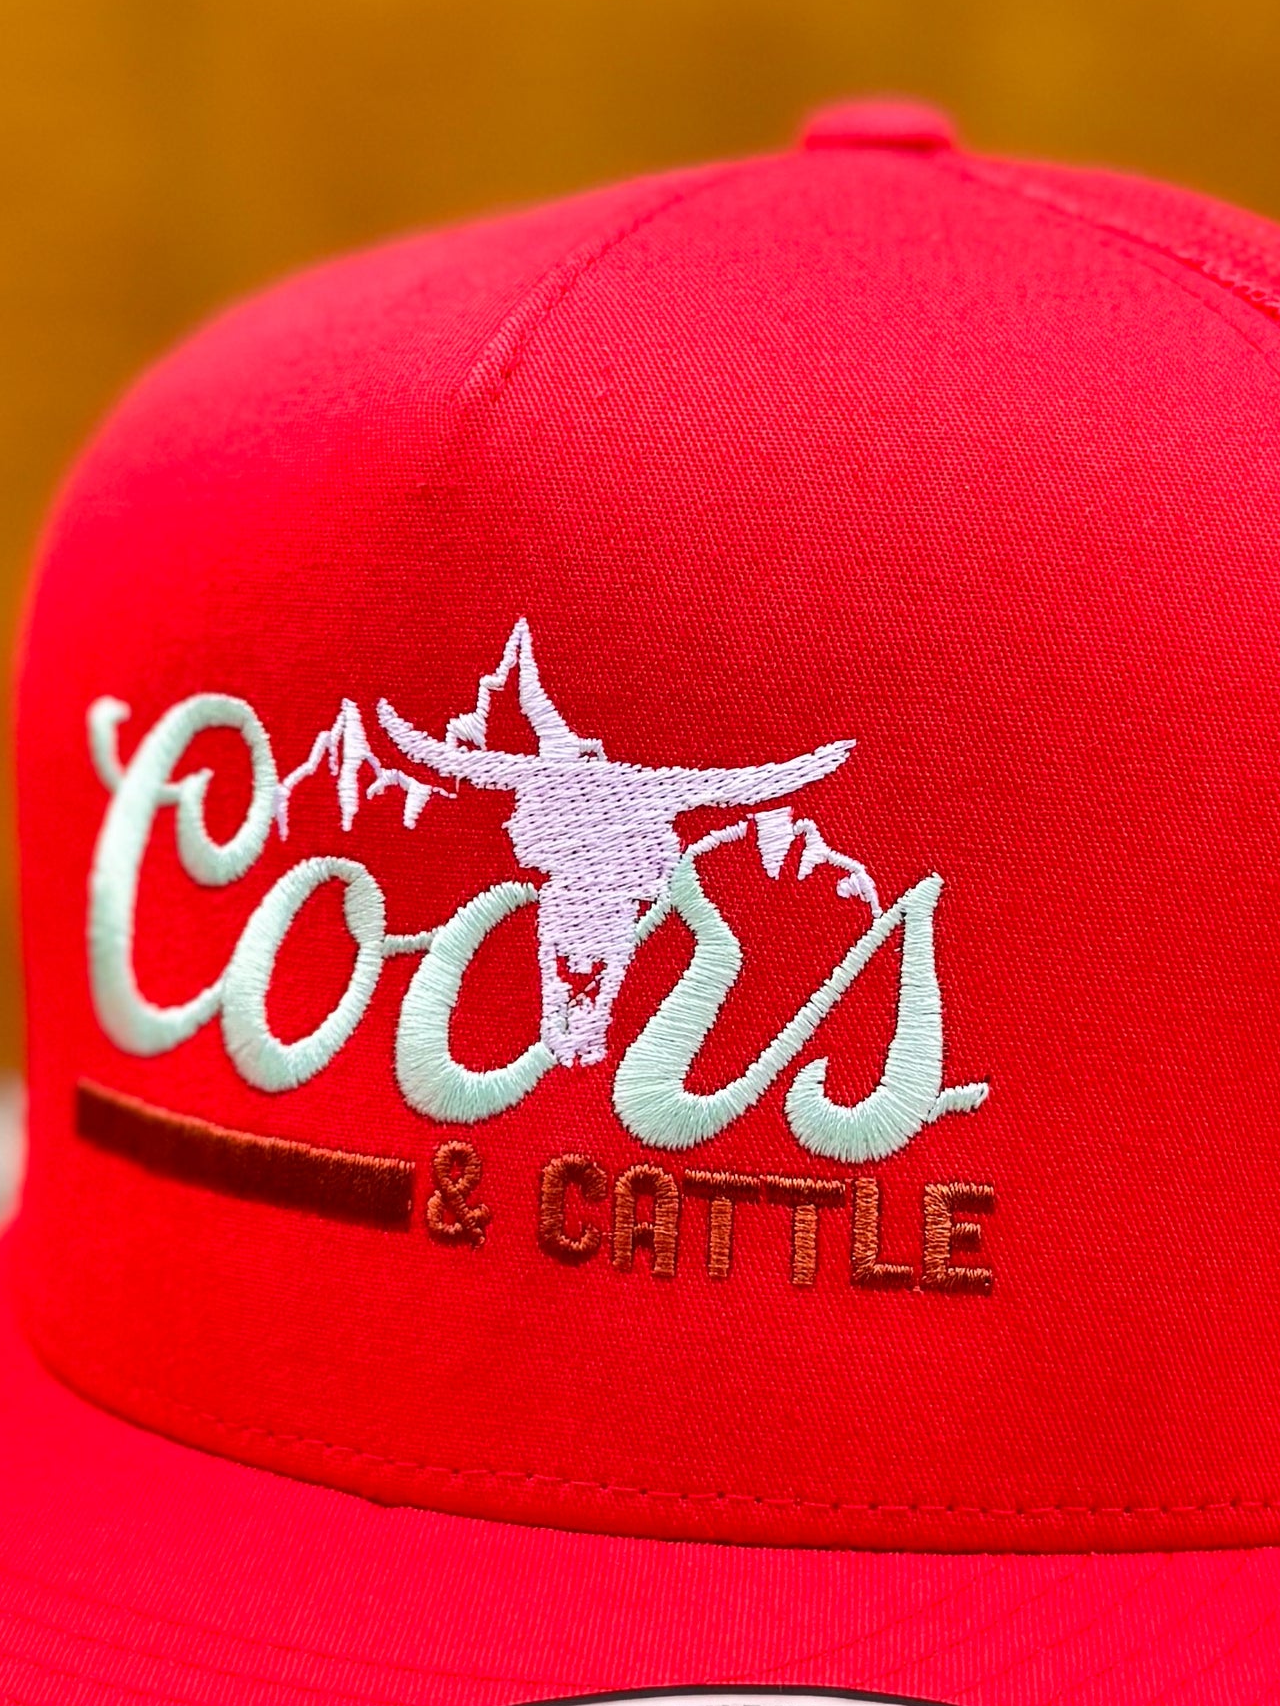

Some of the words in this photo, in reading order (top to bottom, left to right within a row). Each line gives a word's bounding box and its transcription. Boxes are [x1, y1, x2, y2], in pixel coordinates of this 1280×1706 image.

[88, 693, 990, 1163] Coors
[428, 1141, 490, 1249] &
[538, 1154, 995, 1293] CATTLE
